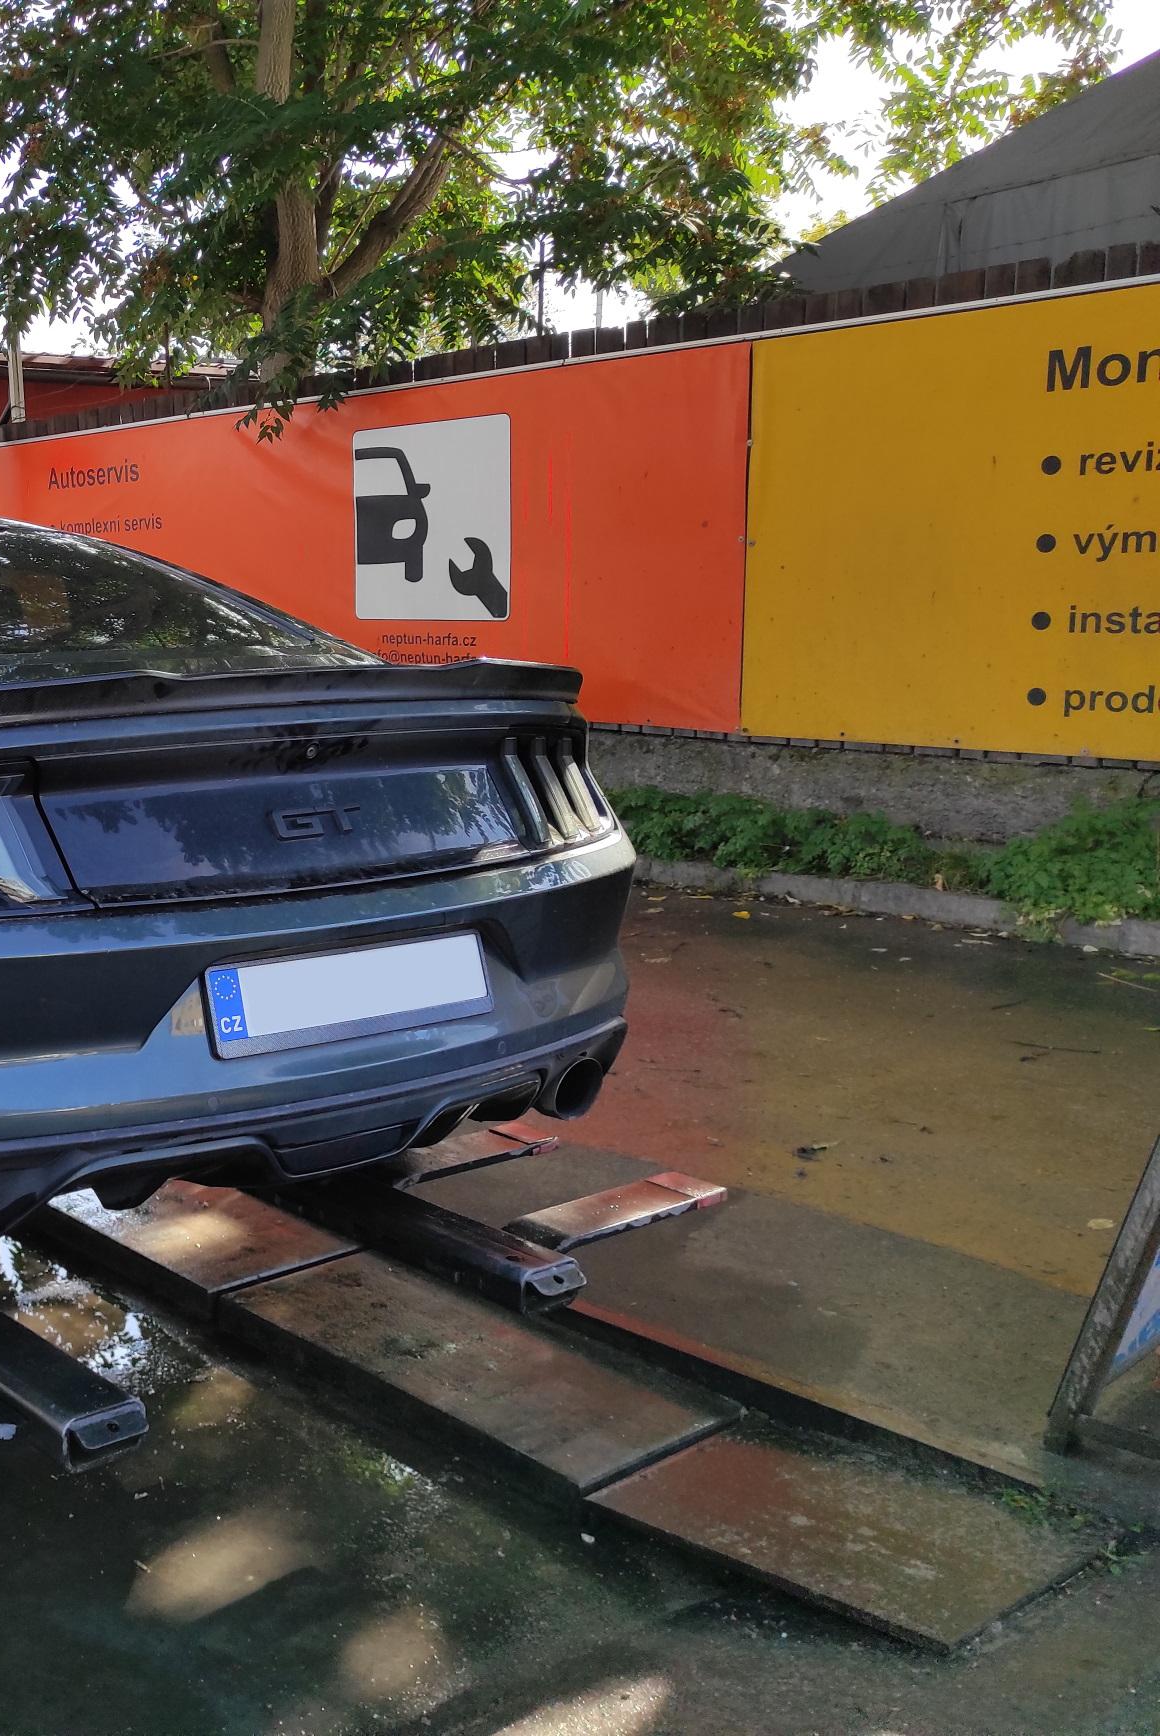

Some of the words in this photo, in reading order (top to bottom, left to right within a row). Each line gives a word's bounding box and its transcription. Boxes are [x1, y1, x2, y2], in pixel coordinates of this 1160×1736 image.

[1080, 441, 1160, 475] revi
[48, 459, 140, 490] Autoservis
[60, 514, 120, 535] komplexní
[124, 513, 162, 532] servis
[1073, 524, 1157, 562] vým
[1068, 605, 1160, 634] insta
[382, 632, 477, 647] neptun-harfa.cz
[1064, 685, 1160, 717] prod
[268, 805, 360, 841] GT
[220, 1015, 243, 1034] CZ
